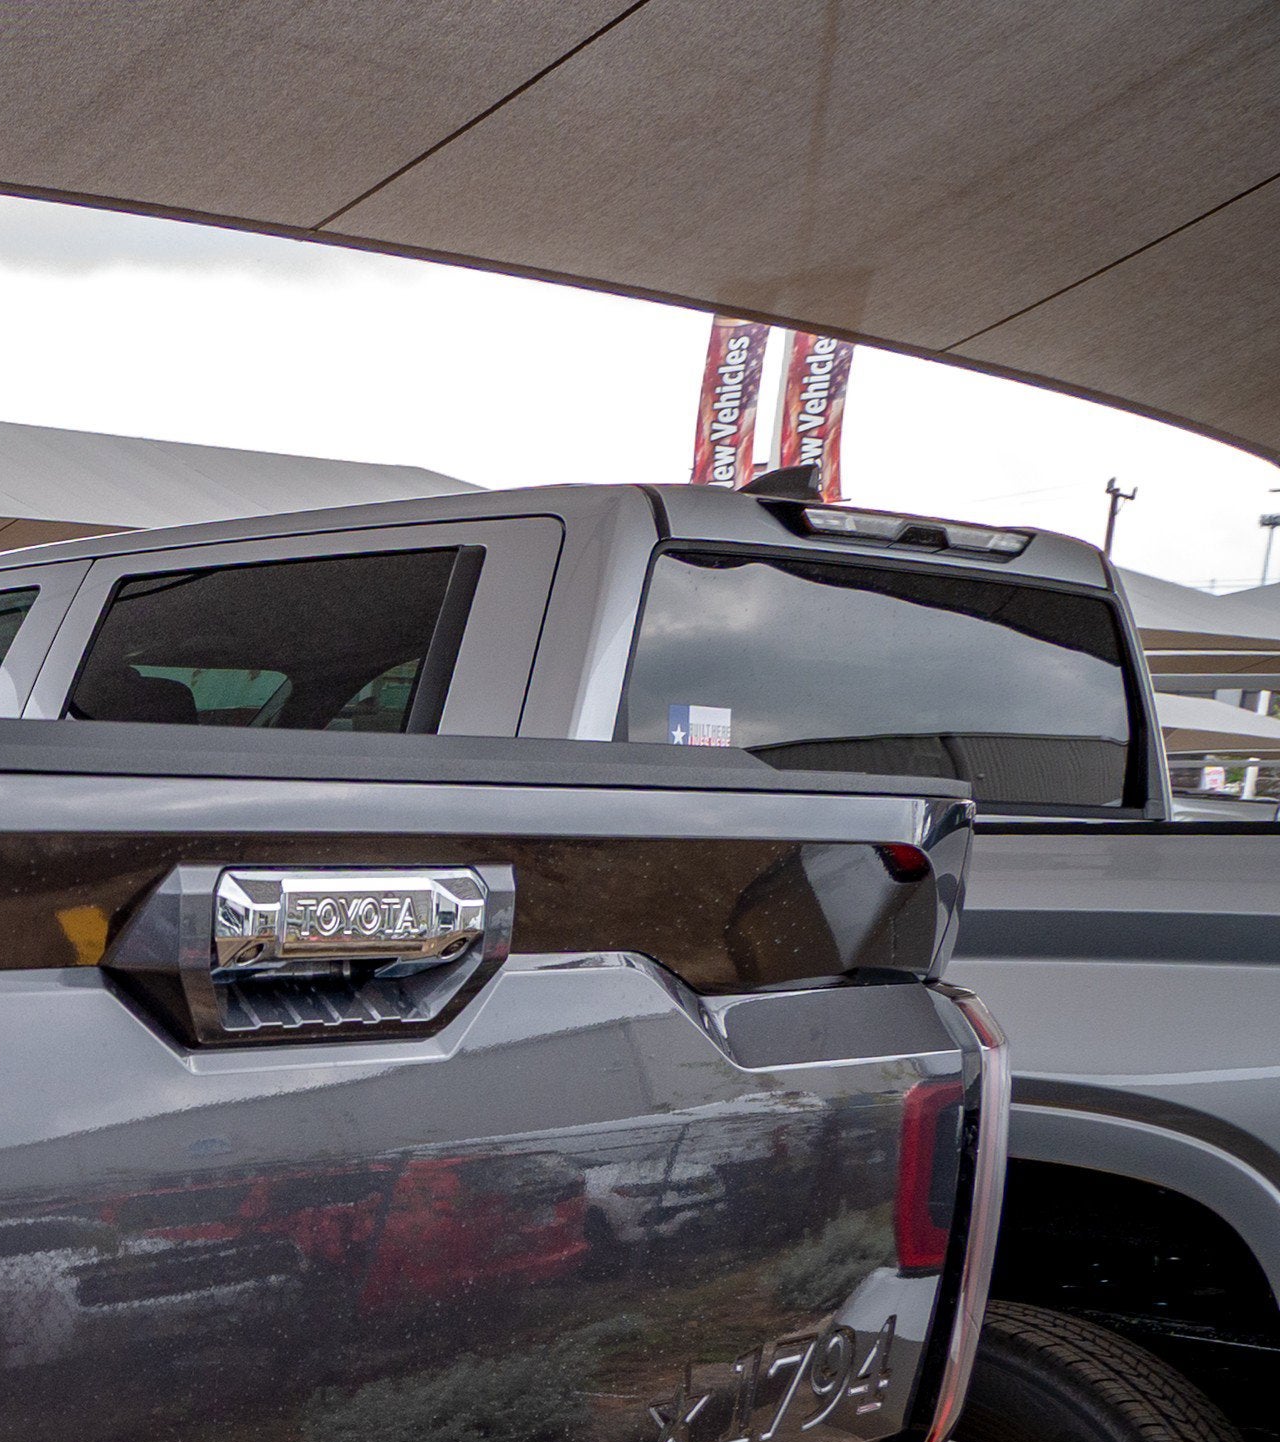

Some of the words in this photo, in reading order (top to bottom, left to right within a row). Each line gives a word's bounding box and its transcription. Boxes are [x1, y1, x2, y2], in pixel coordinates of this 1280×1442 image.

[710, 335, 751, 442] Vehicles
[797, 335, 838, 433] Vehicle
[296, 897, 420, 937] TOYOTA
